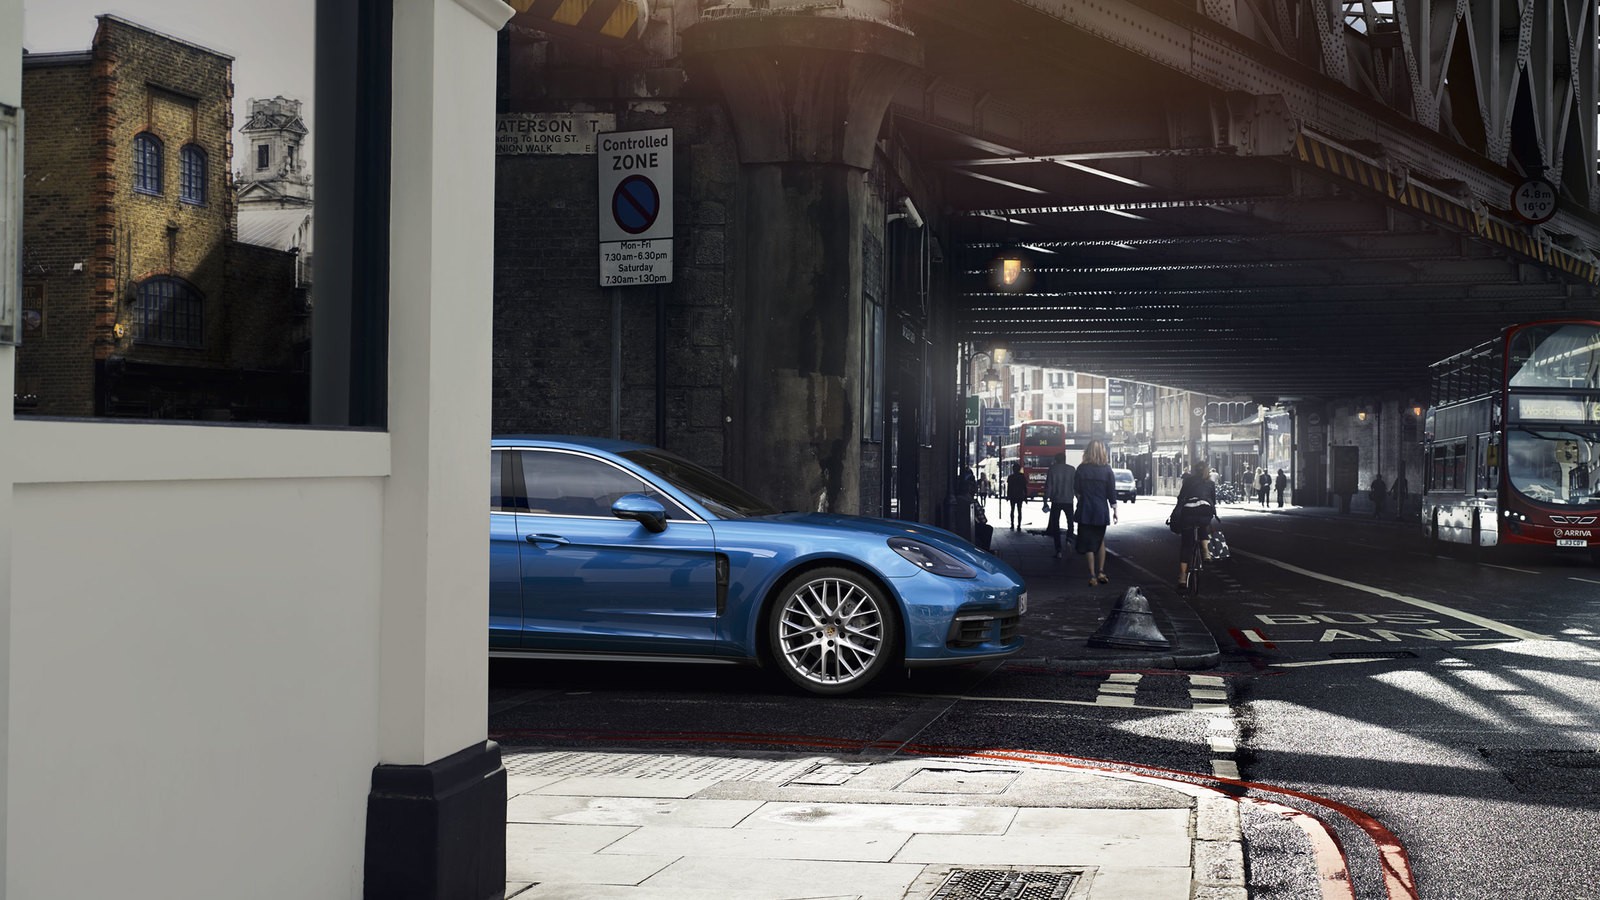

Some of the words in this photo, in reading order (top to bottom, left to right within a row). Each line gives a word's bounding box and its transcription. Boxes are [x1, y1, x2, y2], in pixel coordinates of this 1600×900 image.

[496, 120, 572, 133] ATERSON
[496, 135, 518, 144] ading
[534, 135, 561, 143] LONG
[564, 135, 579, 143] ST.
[603, 135, 668, 151] Controlled
[612, 152, 659, 171] ZONE
[1521, 188, 1551, 199] 4.8m
[620, 240, 651, 250] Mon-Fri
[605, 251, 667, 262] 7.30am-6.30pm
[618, 263, 653, 273] Saturday
[605, 274, 667, 284] 7.30am-1.30pm
[1523, 405, 1550, 416] Wood
[1554, 406, 1582, 418] Green
[1564, 529, 1593, 537] ARRIVA
[1254, 613, 1441, 625] BUS
[1241, 628, 1521, 643] LANE
